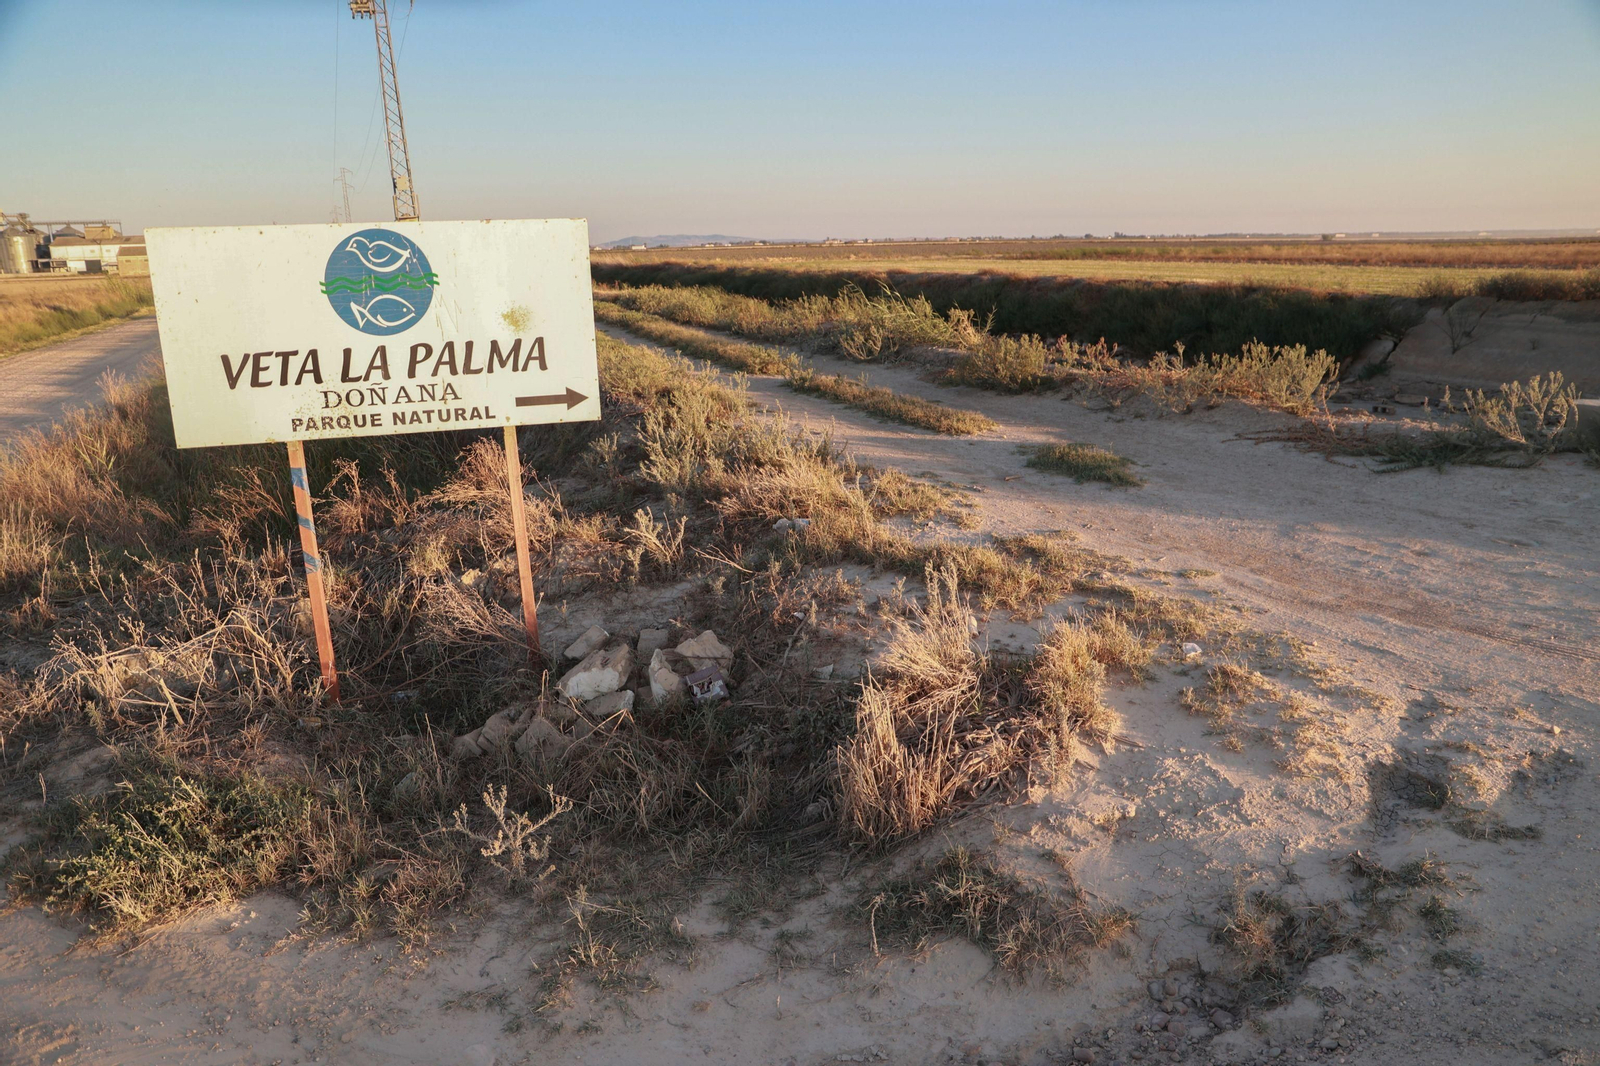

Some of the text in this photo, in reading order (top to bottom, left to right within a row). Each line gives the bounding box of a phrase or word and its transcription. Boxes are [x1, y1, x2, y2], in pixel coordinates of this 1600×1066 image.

[220, 336, 548, 390] VETA LA PALMA
[320, 381, 462, 409] DOÑANA
[291, 406, 497, 432] PARQUE NATURAL
